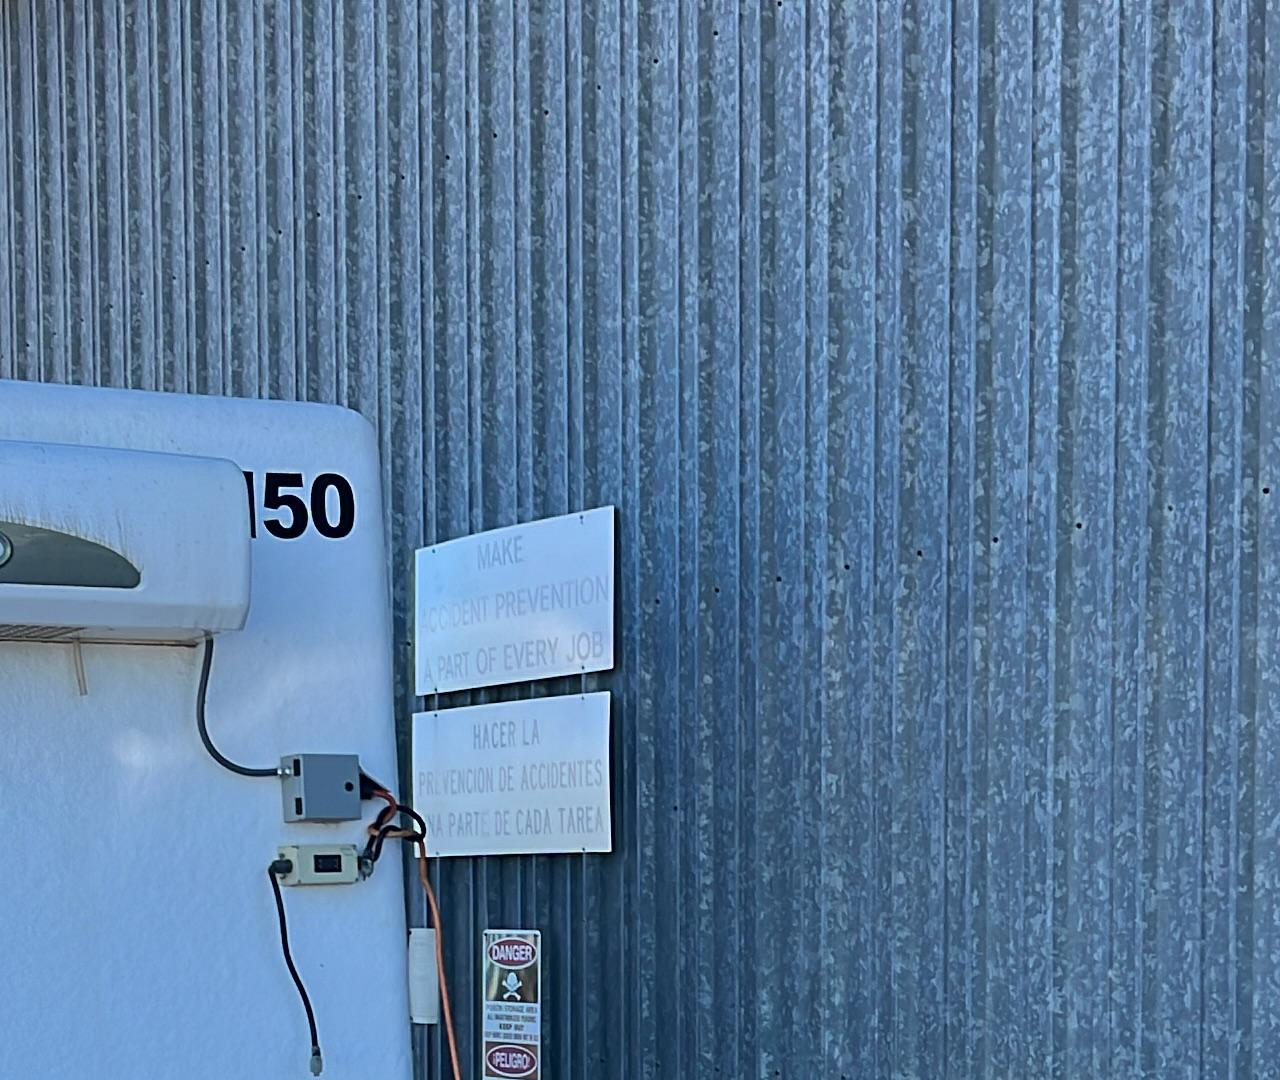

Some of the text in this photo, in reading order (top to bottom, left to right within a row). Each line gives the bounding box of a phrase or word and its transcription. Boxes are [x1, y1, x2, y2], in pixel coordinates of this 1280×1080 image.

[477, 536, 525, 570] MAKE
[495, 576, 609, 620] PREVENTION
[423, 631, 604, 685] A PART OF EVERY JOB
[472, 719, 540, 750] HACER LA
[419, 758, 602, 797] PREVENCION DE ACCIDENTES
[425, 806, 604, 838] NA PARTE DE CADA TAREA
[491, 944, 533, 961] DANGER
